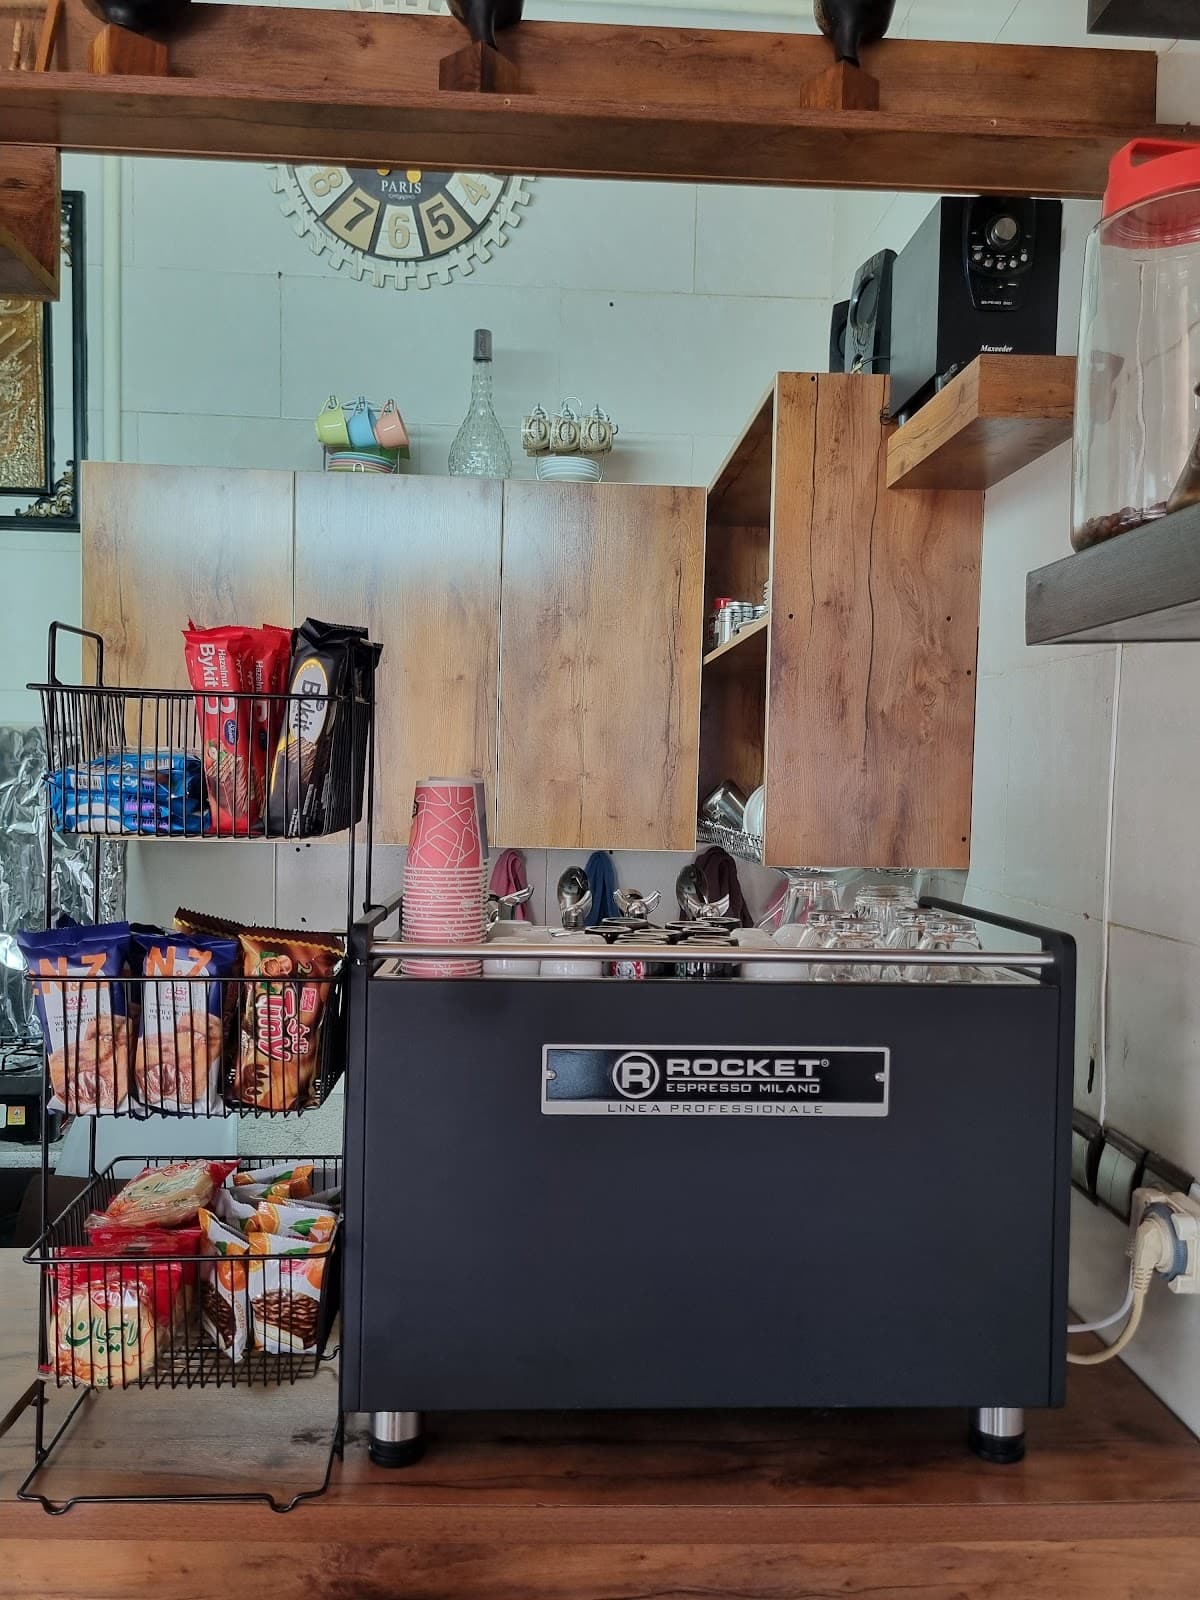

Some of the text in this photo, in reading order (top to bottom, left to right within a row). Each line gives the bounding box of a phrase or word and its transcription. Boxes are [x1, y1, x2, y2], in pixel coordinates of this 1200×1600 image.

[381, 180, 422, 194] PARIS
[458, 174, 491, 206] 4
[345, 198, 374, 231] 7
[387, 212, 411, 249] 6
[425, 201, 456, 240] 5
[197, 643, 219, 688] Bykit
[217, 648, 229, 688] Hazelnut
[257, 988, 296, 1061] Tiny
[666, 1083, 820, 1093] ESPRESSO MILANO
[607, 1103, 824, 1114] LINEA PROFESSIONALE
